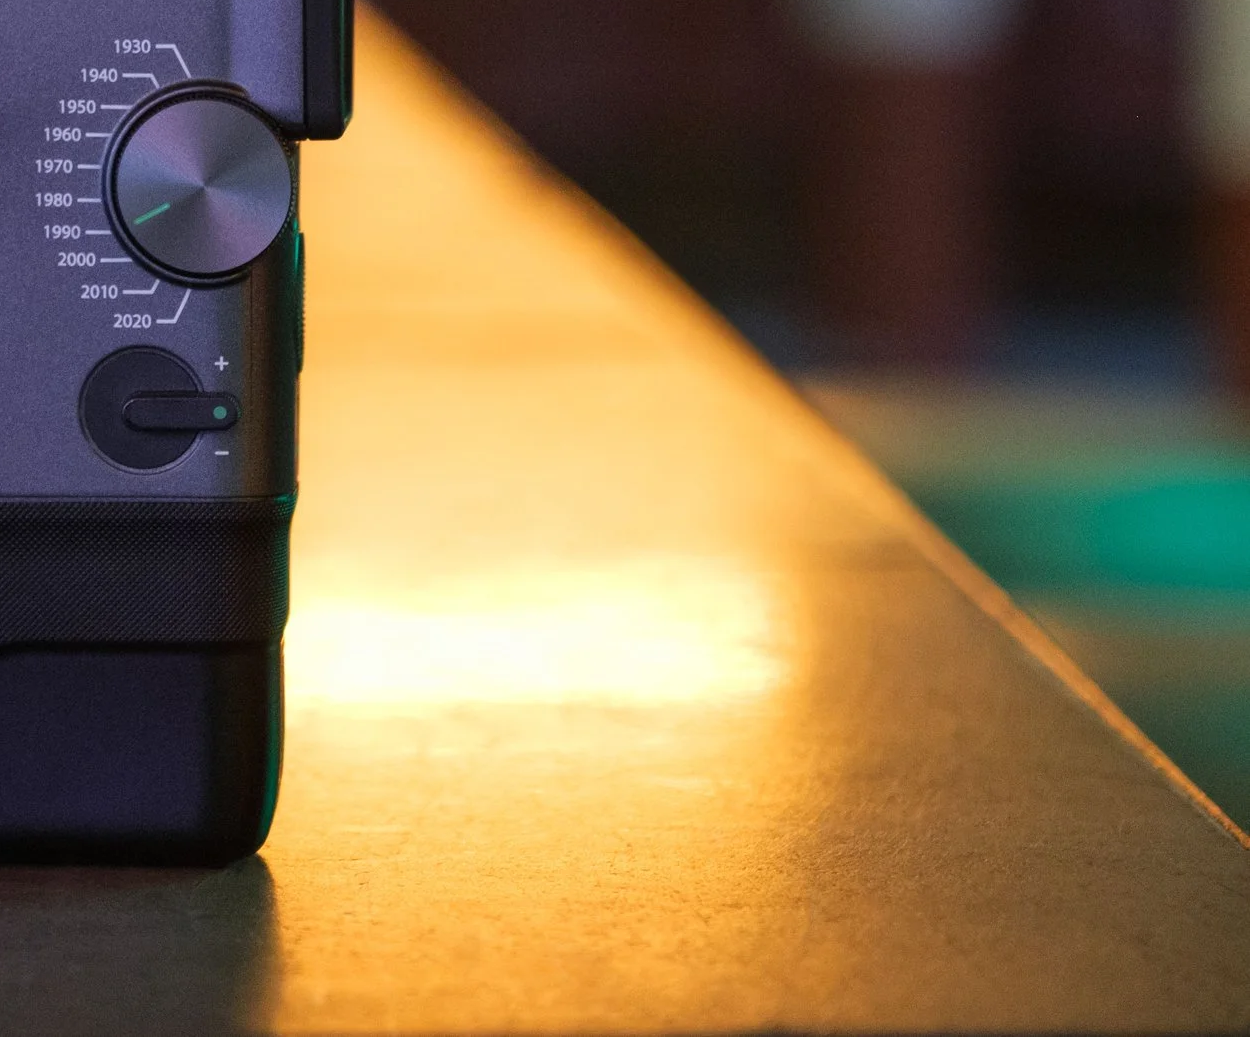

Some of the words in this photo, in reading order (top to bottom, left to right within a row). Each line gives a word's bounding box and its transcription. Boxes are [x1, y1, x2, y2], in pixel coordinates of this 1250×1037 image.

[113, 39, 151, 53] 1930
[80, 68, 118, 82] 1940
[58, 100, 96, 114] 1950
[43, 128, 81, 142] 1960
[35, 159, 73, 174] 1970
[35, 193, 73, 207] 1980
[43, 225, 81, 239] 1990
[57, 252, 96, 267] 2000
[80, 285, 118, 299] 2010
[113, 314, 151, 328] 2020
